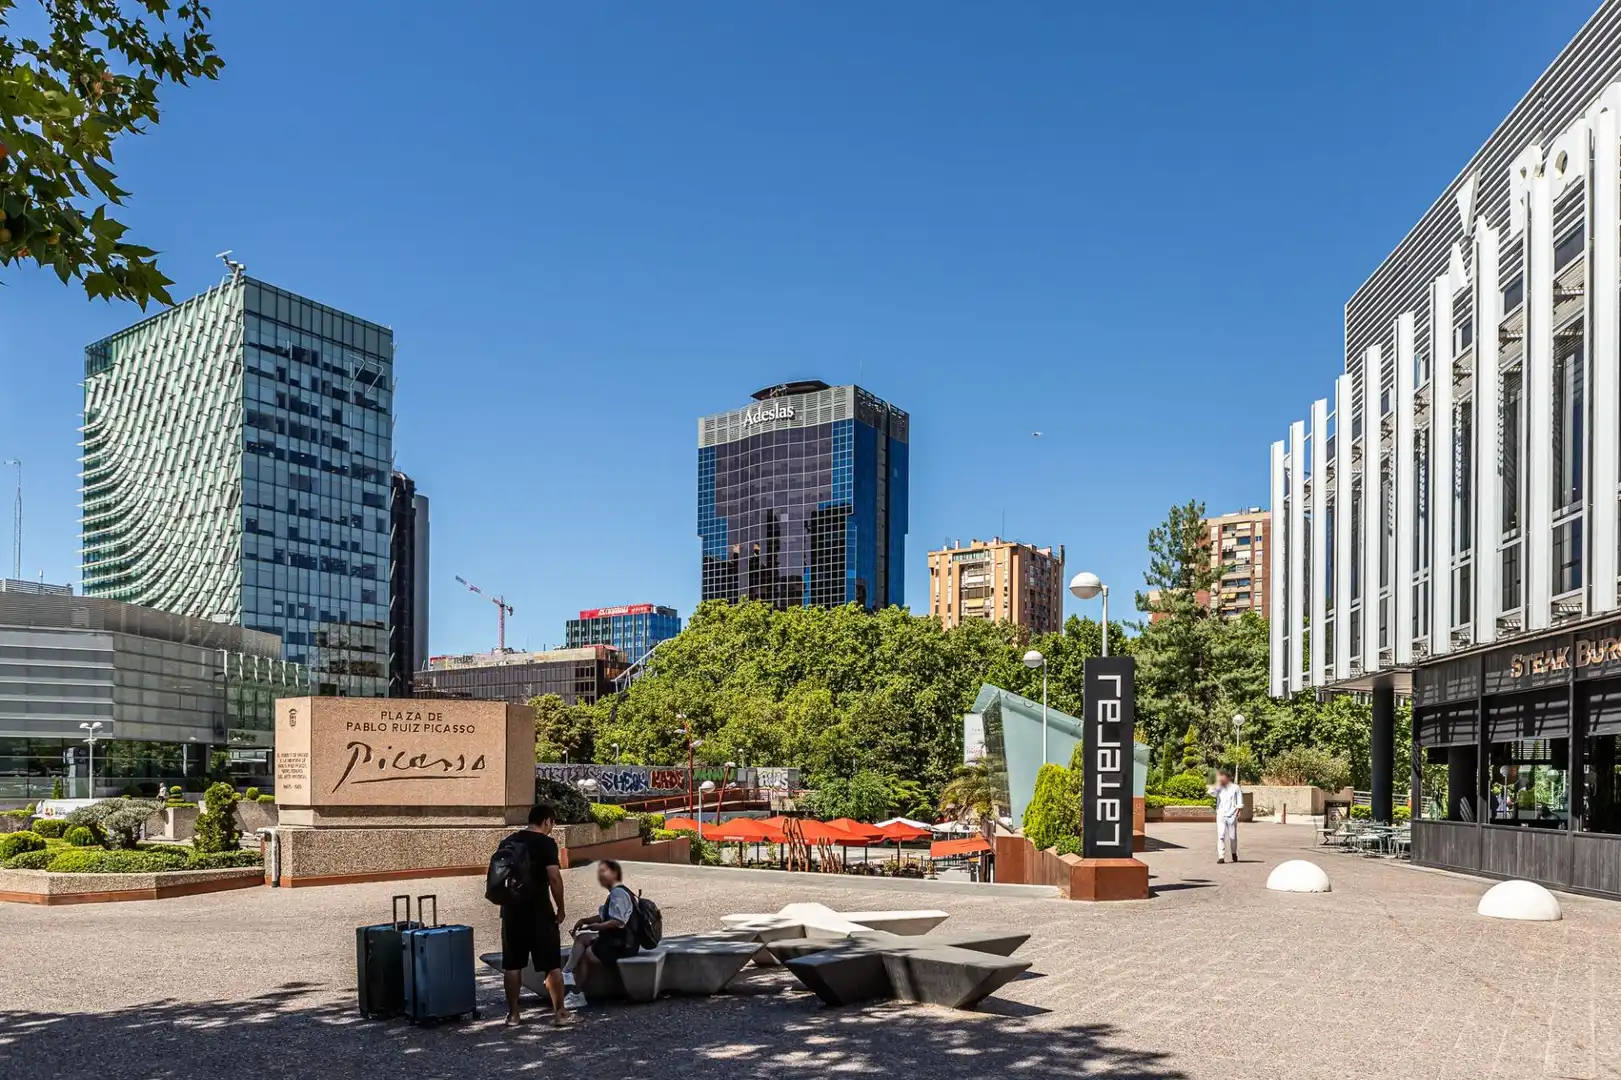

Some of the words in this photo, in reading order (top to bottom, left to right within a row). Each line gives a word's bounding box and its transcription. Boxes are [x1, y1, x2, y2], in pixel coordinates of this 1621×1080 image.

[742, 402, 794, 427] Adeslas
[1510, 646, 1571, 678] STEAK
[346, 721, 388, 732] PABLO
[391, 723, 420, 733] RUIZ
[423, 723, 476, 734] PICASSO
[380, 711, 422, 721] PLAZA
[428, 712, 443, 722] DE
[332, 741, 486, 793] Picasso
